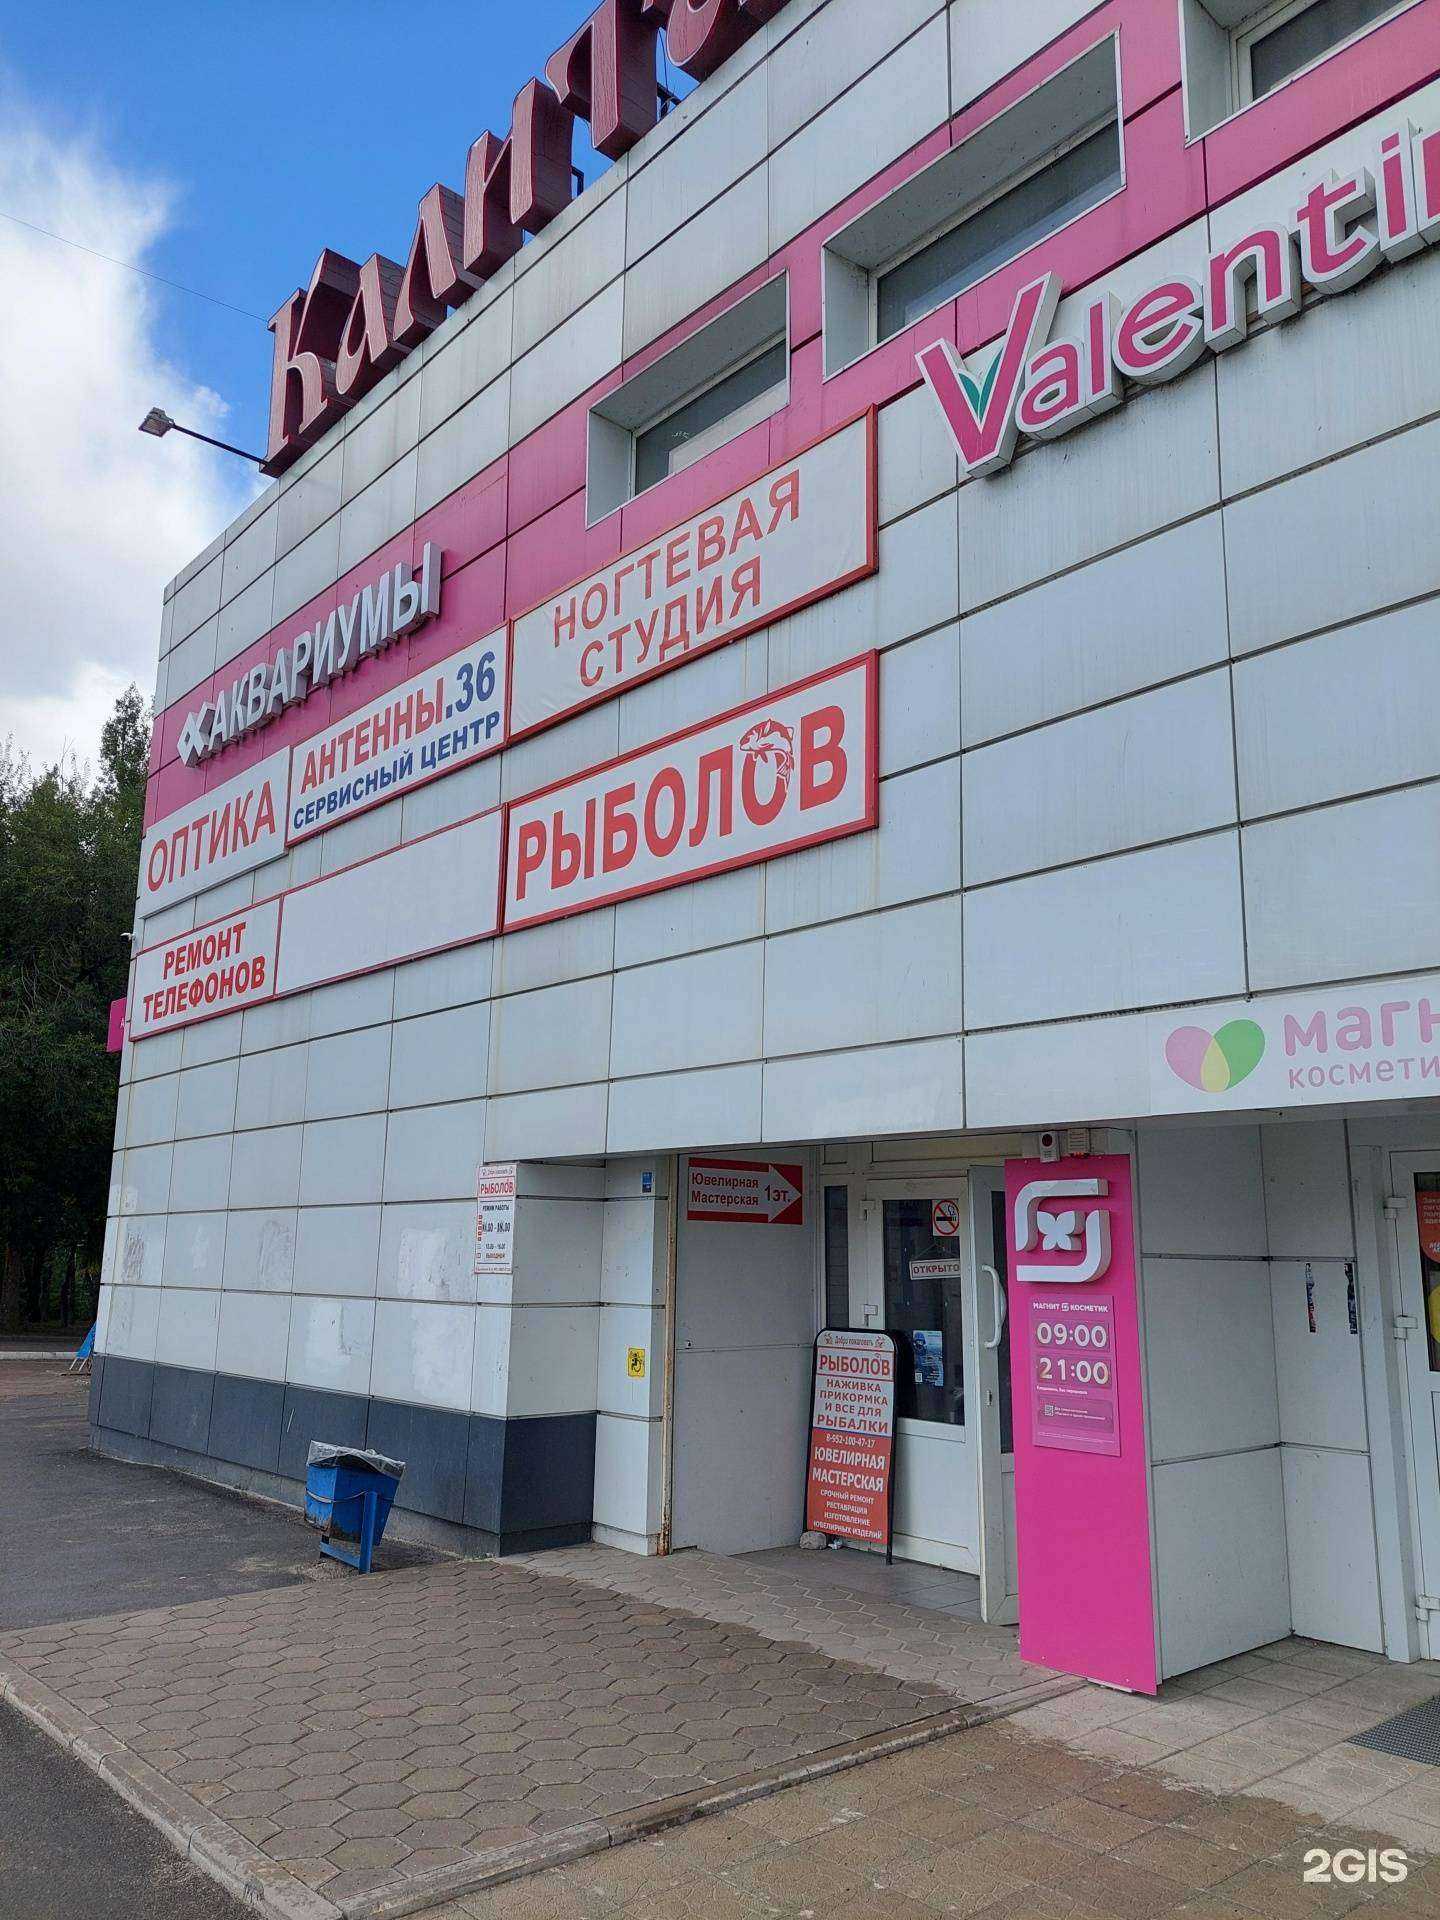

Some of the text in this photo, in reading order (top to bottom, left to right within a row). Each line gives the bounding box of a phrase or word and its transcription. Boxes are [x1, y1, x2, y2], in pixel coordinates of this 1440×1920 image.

[915, 126, 1440, 474] Valenti
[553, 469, 799, 647] НОГТЕВАЯ
[580, 555, 761, 687] СТУДИЯ
[208, 541, 443, 747] АКВАРИУМЫ
[293, 710, 500, 830] СЕРВИСНЫЙ ЦЕНТР
[515, 705, 847, 901] РЫБОЛОВ
[147, 779, 276, 892] ОПТИКА
[163, 921, 247, 980] РЕМОНТ
[143, 955, 265, 1023] ТЕЛЕФОНОВ
[480, 1181, 514, 1195] РЫБОЛОВ
[691, 1172, 759, 1188] Ювелирная
[691, 1190, 759, 1207] Мастерская
[913, 1263, 960, 1274] ОТКРЫТО
[1032, 1302, 1109, 1313] МАГНИТ КОСМЕТИК
[1036, 1322, 1107, 1348] 09:00
[818, 1353, 890, 1376] РЫБОЛОВ
[1039, 1357, 1110, 1385] 21:00
[819, 1390, 888, 1406] ПРИКОРМКА
[826, 1379, 881, 1393] НАЖИВКА
[825, 1402, 882, 1418] И ВСЕ ДЛЯ
[817, 1414, 889, 1434] РЫБАЛКИ
[814, 1446, 886, 1471] ЮВЕЛИРНАЯ
[812, 1467, 884, 1493] МАСТЕРСКАЯ
[820, 1489, 875, 1505] СРОЧНЫЙ РЕМОНТ
